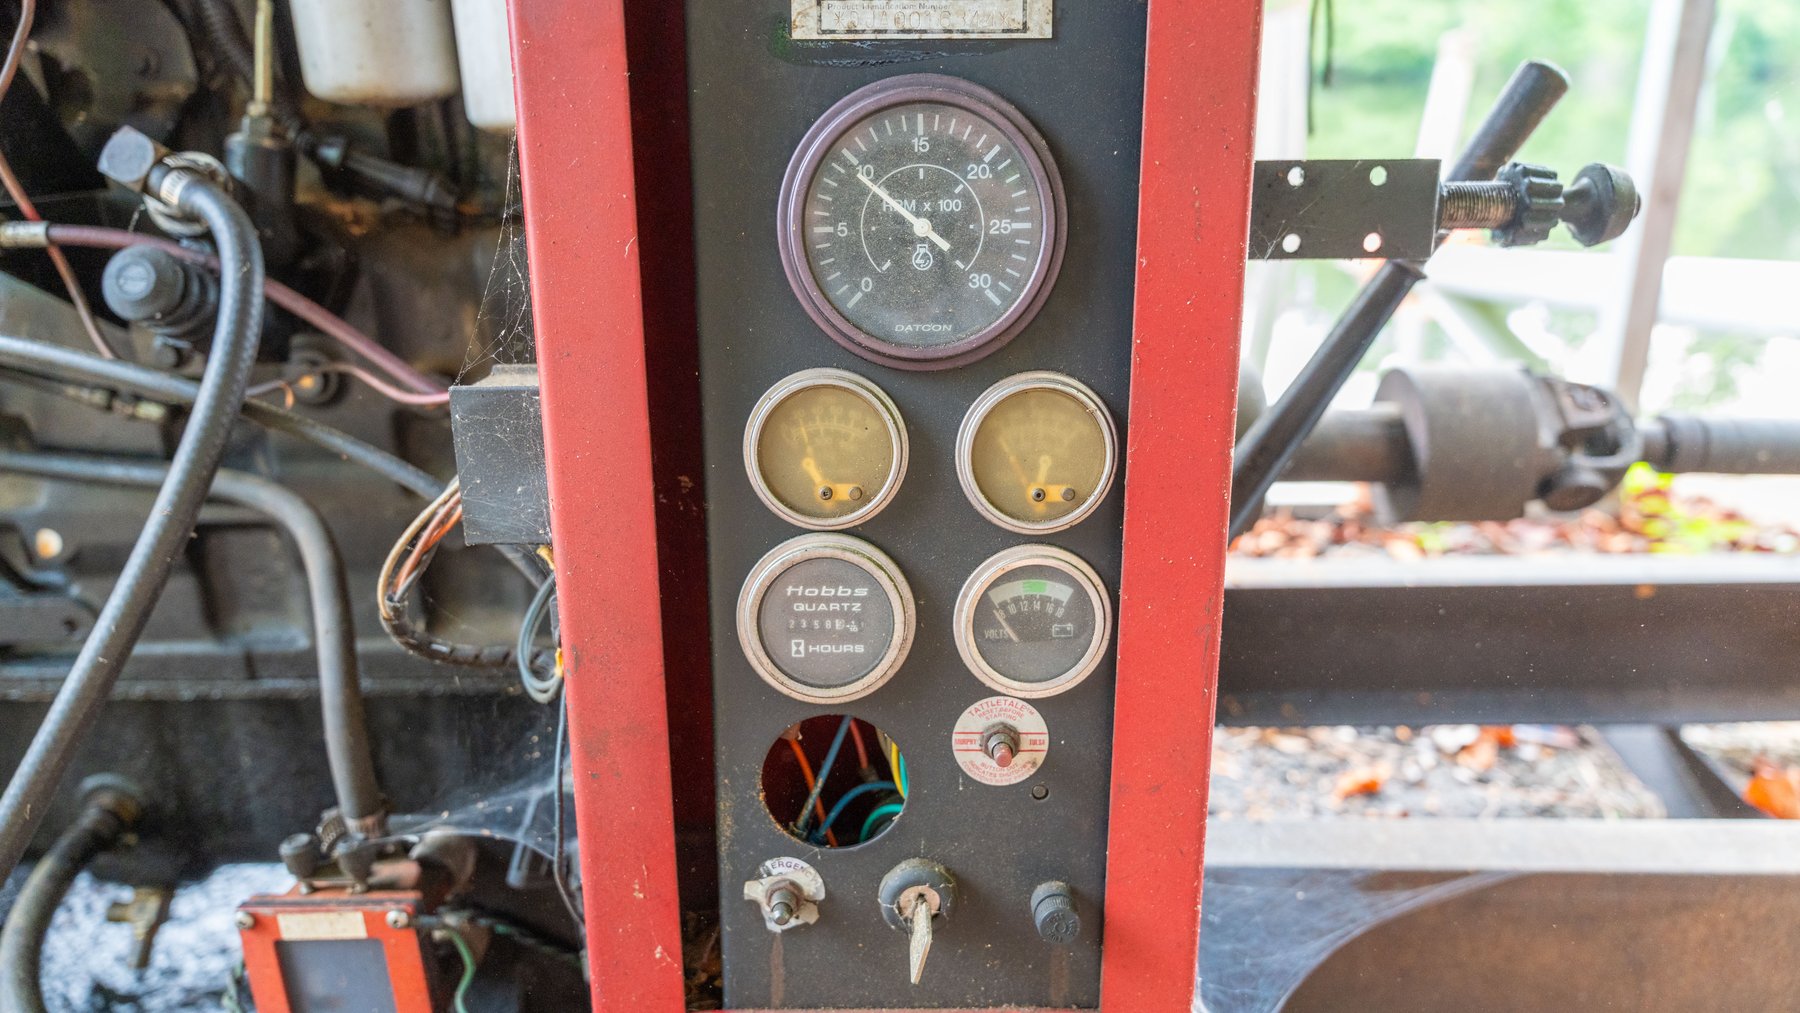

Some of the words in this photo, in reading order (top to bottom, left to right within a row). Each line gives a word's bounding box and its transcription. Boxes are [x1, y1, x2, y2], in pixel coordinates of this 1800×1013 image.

[912, 138, 929, 152] 15
[856, 165, 874, 179] 10
[967, 164, 989, 179] 20
[938, 200, 962, 212] 100
[838, 223, 848, 236] 5
[989, 220, 1011, 234] 25
[861, 278, 872, 291] 0
[969, 274, 991, 288] 30
[895, 324, 952, 332] DATCON
[786, 586, 868, 596] Hobbs
[793, 603, 862, 611] QUARTZ
[1008, 603, 1017, 614] 10
[1020, 601, 1028, 611] 12
[1034, 600, 1040, 610] 14
[1046, 603, 1054, 614] 16
[1055, 607, 1064, 618] 18
[984, 629, 1009, 638] VOLTS
[809, 645, 864, 653] HOURS
